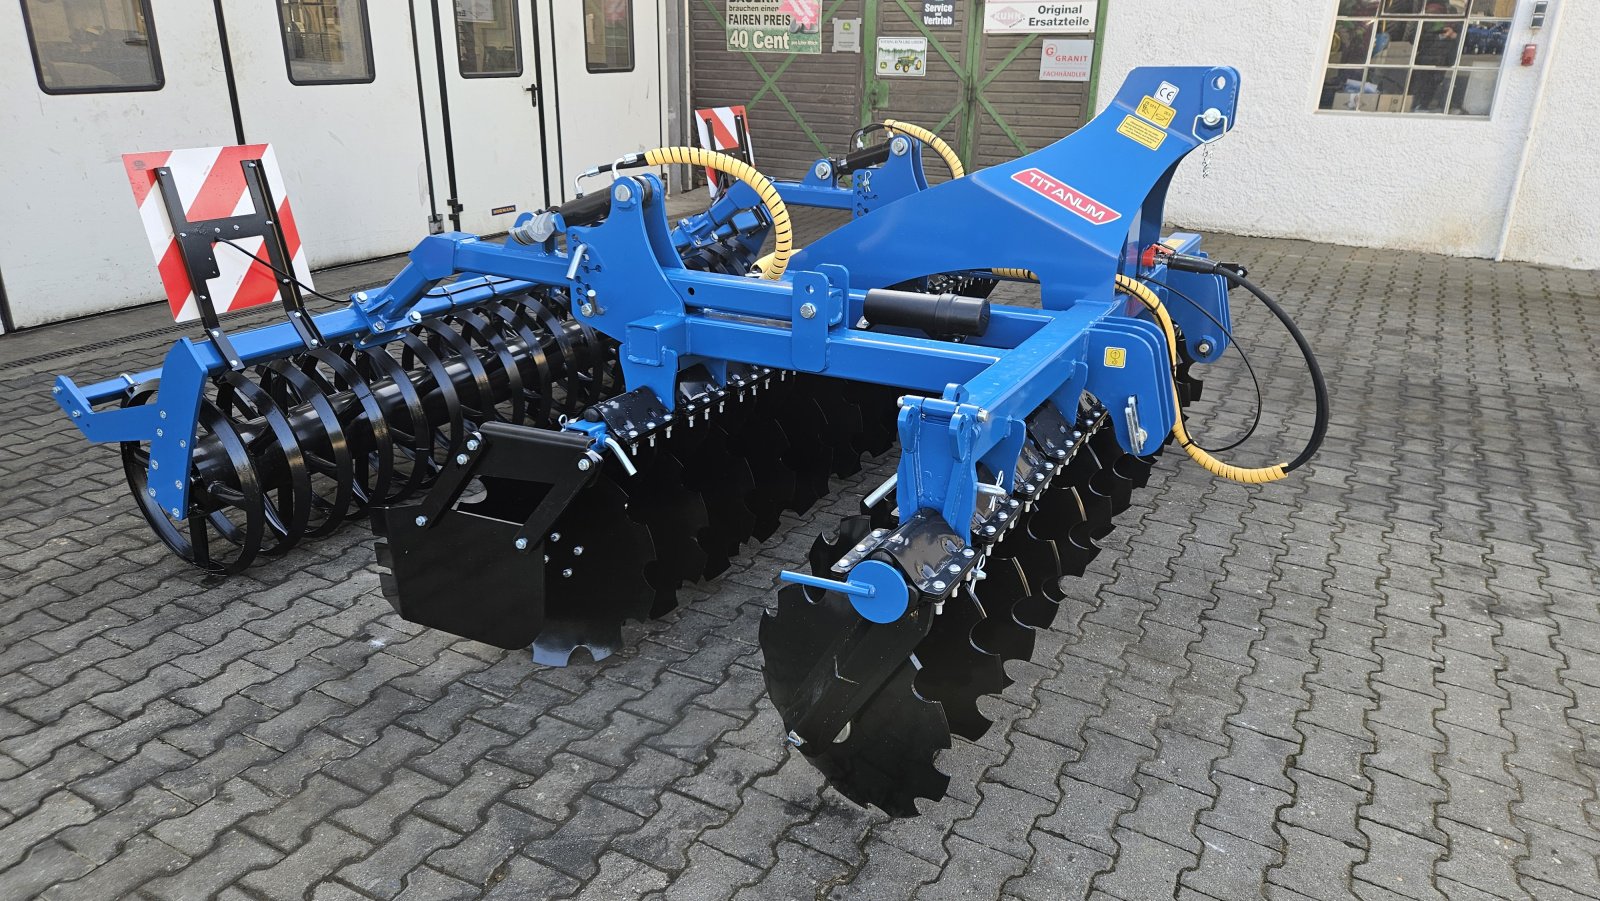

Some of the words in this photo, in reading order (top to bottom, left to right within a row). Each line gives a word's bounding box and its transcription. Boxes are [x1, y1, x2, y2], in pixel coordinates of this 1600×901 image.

[925, 3, 953, 12] Service
[1038, 5, 1082, 16] Original
[729, 14, 761, 26] FAIREN
[764, 15, 791, 26] PREIS
[923, 16, 953, 25] Vertrieb
[1028, 17, 1090, 26] Ersatzteile
[729, 30, 749, 48] 40
[753, 31, 790, 50] Cent
[1159, 87, 1175, 101] CE
[1027, 171, 1106, 220] TITANUM
